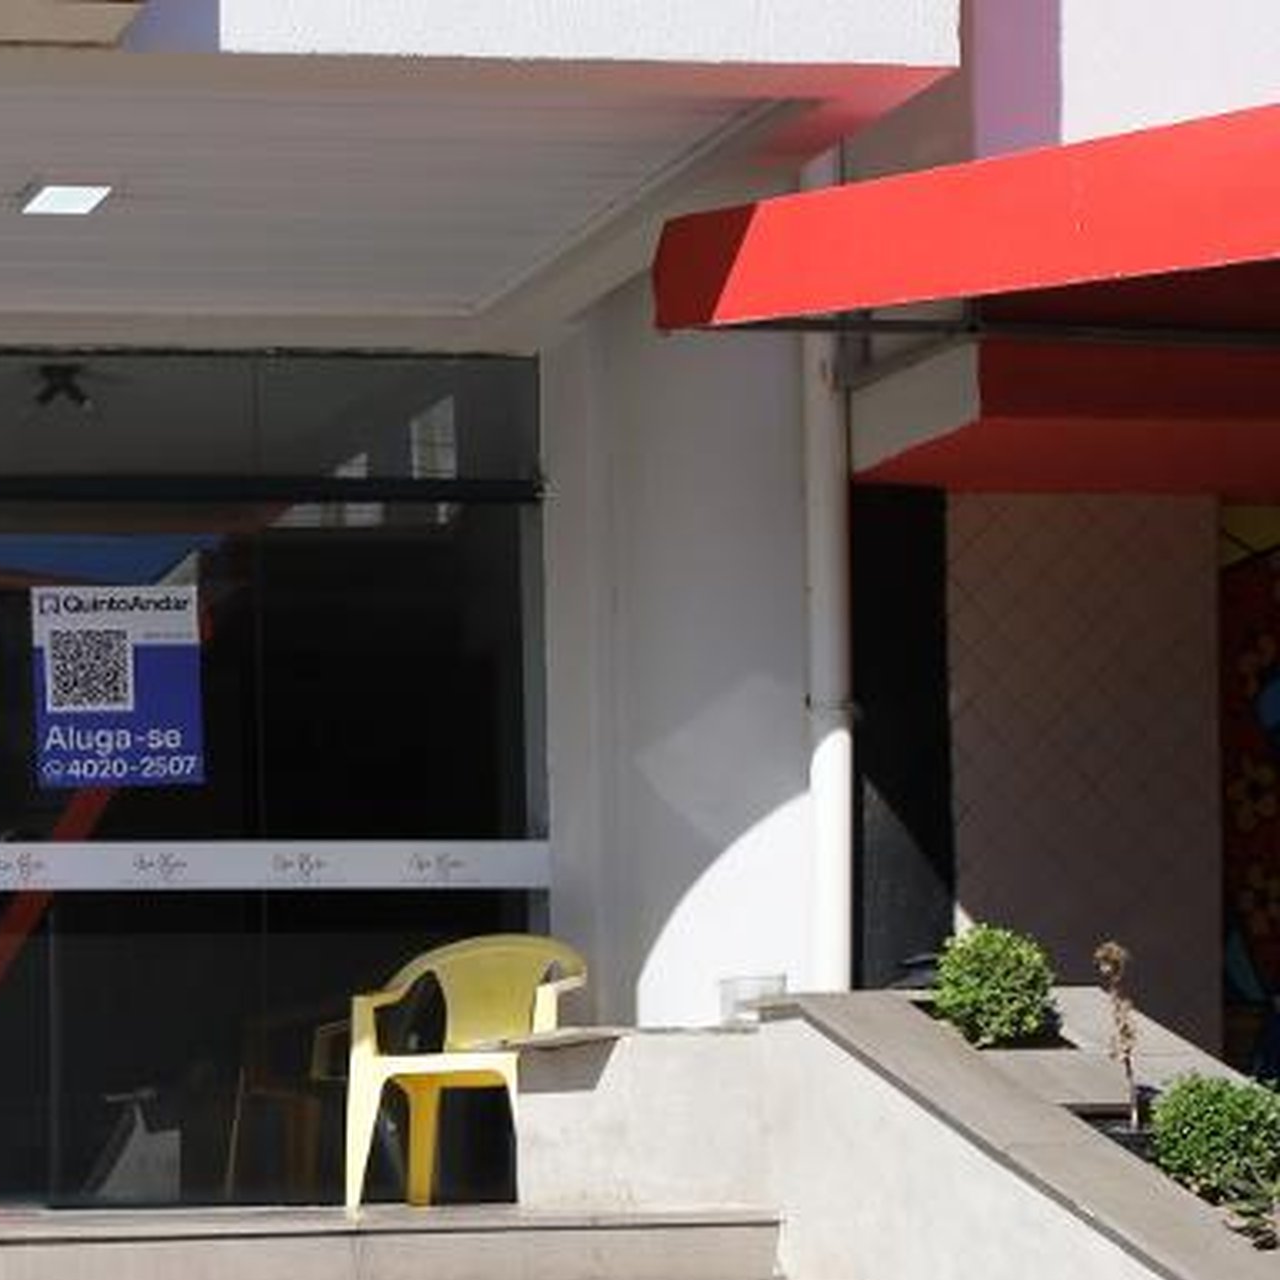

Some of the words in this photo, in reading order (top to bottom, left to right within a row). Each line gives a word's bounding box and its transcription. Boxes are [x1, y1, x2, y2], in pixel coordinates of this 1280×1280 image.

[63, 595, 189, 614] QuintoAndar
[44, 724, 182, 756] Aluga-se
[66, 756, 197, 779] 4020-2507
